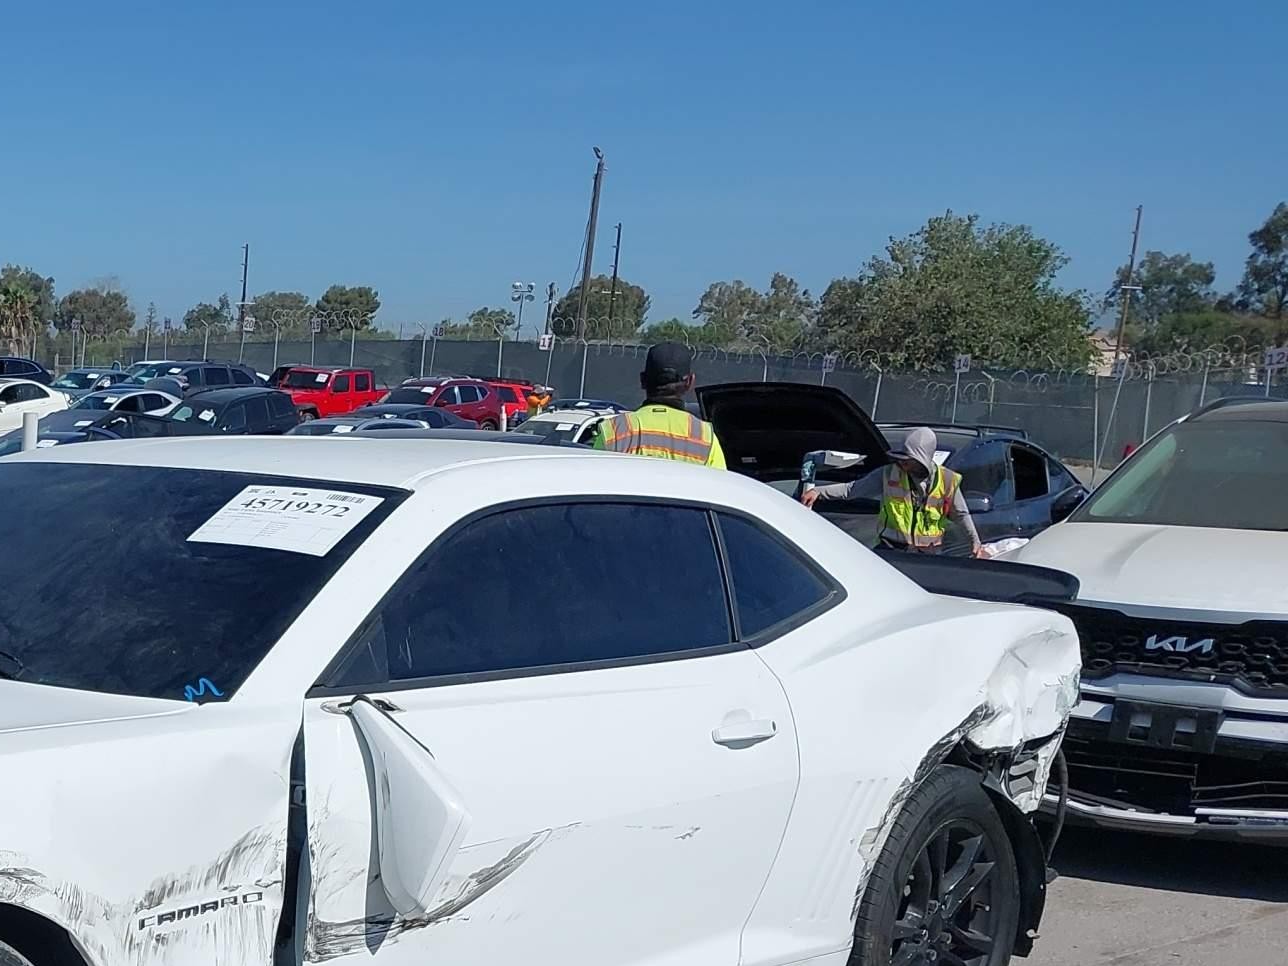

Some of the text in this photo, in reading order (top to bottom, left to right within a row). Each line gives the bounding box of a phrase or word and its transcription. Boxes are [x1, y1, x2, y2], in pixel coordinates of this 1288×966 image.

[244, 320, 255, 329] 20
[311, 320, 320, 331] 19
[434, 327, 444, 337] 18
[824, 358, 834, 369] 15
[956, 357, 969, 370] 14
[1266, 351, 1286, 367] 12
[240, 497, 351, 518] 45719272
[1145, 634, 1215, 653] KIA
[138, 892, 263, 931] CAMARO
